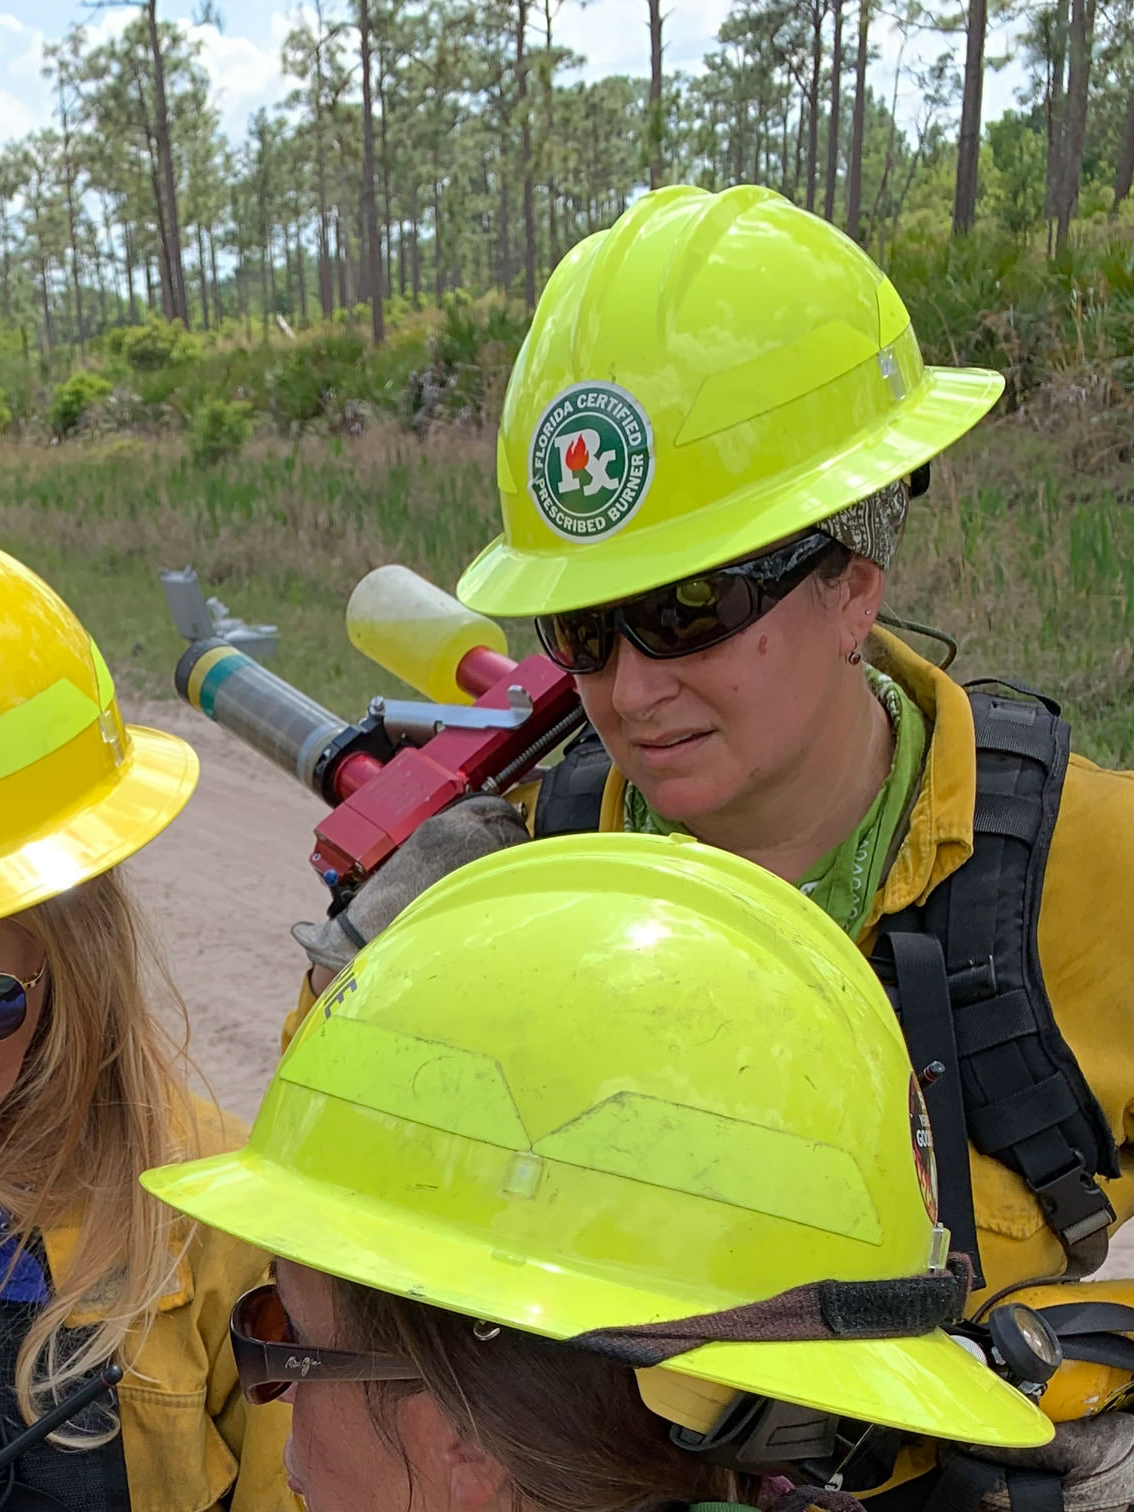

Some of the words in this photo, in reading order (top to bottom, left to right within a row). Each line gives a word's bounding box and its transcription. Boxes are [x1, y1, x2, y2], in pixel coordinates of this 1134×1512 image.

[535, 401, 574, 467] FLORIDA
[577, 393, 643, 447] CERTIFIED
[535, 479, 606, 534] PRESCRIBED
[607, 453, 644, 522] BURNER
